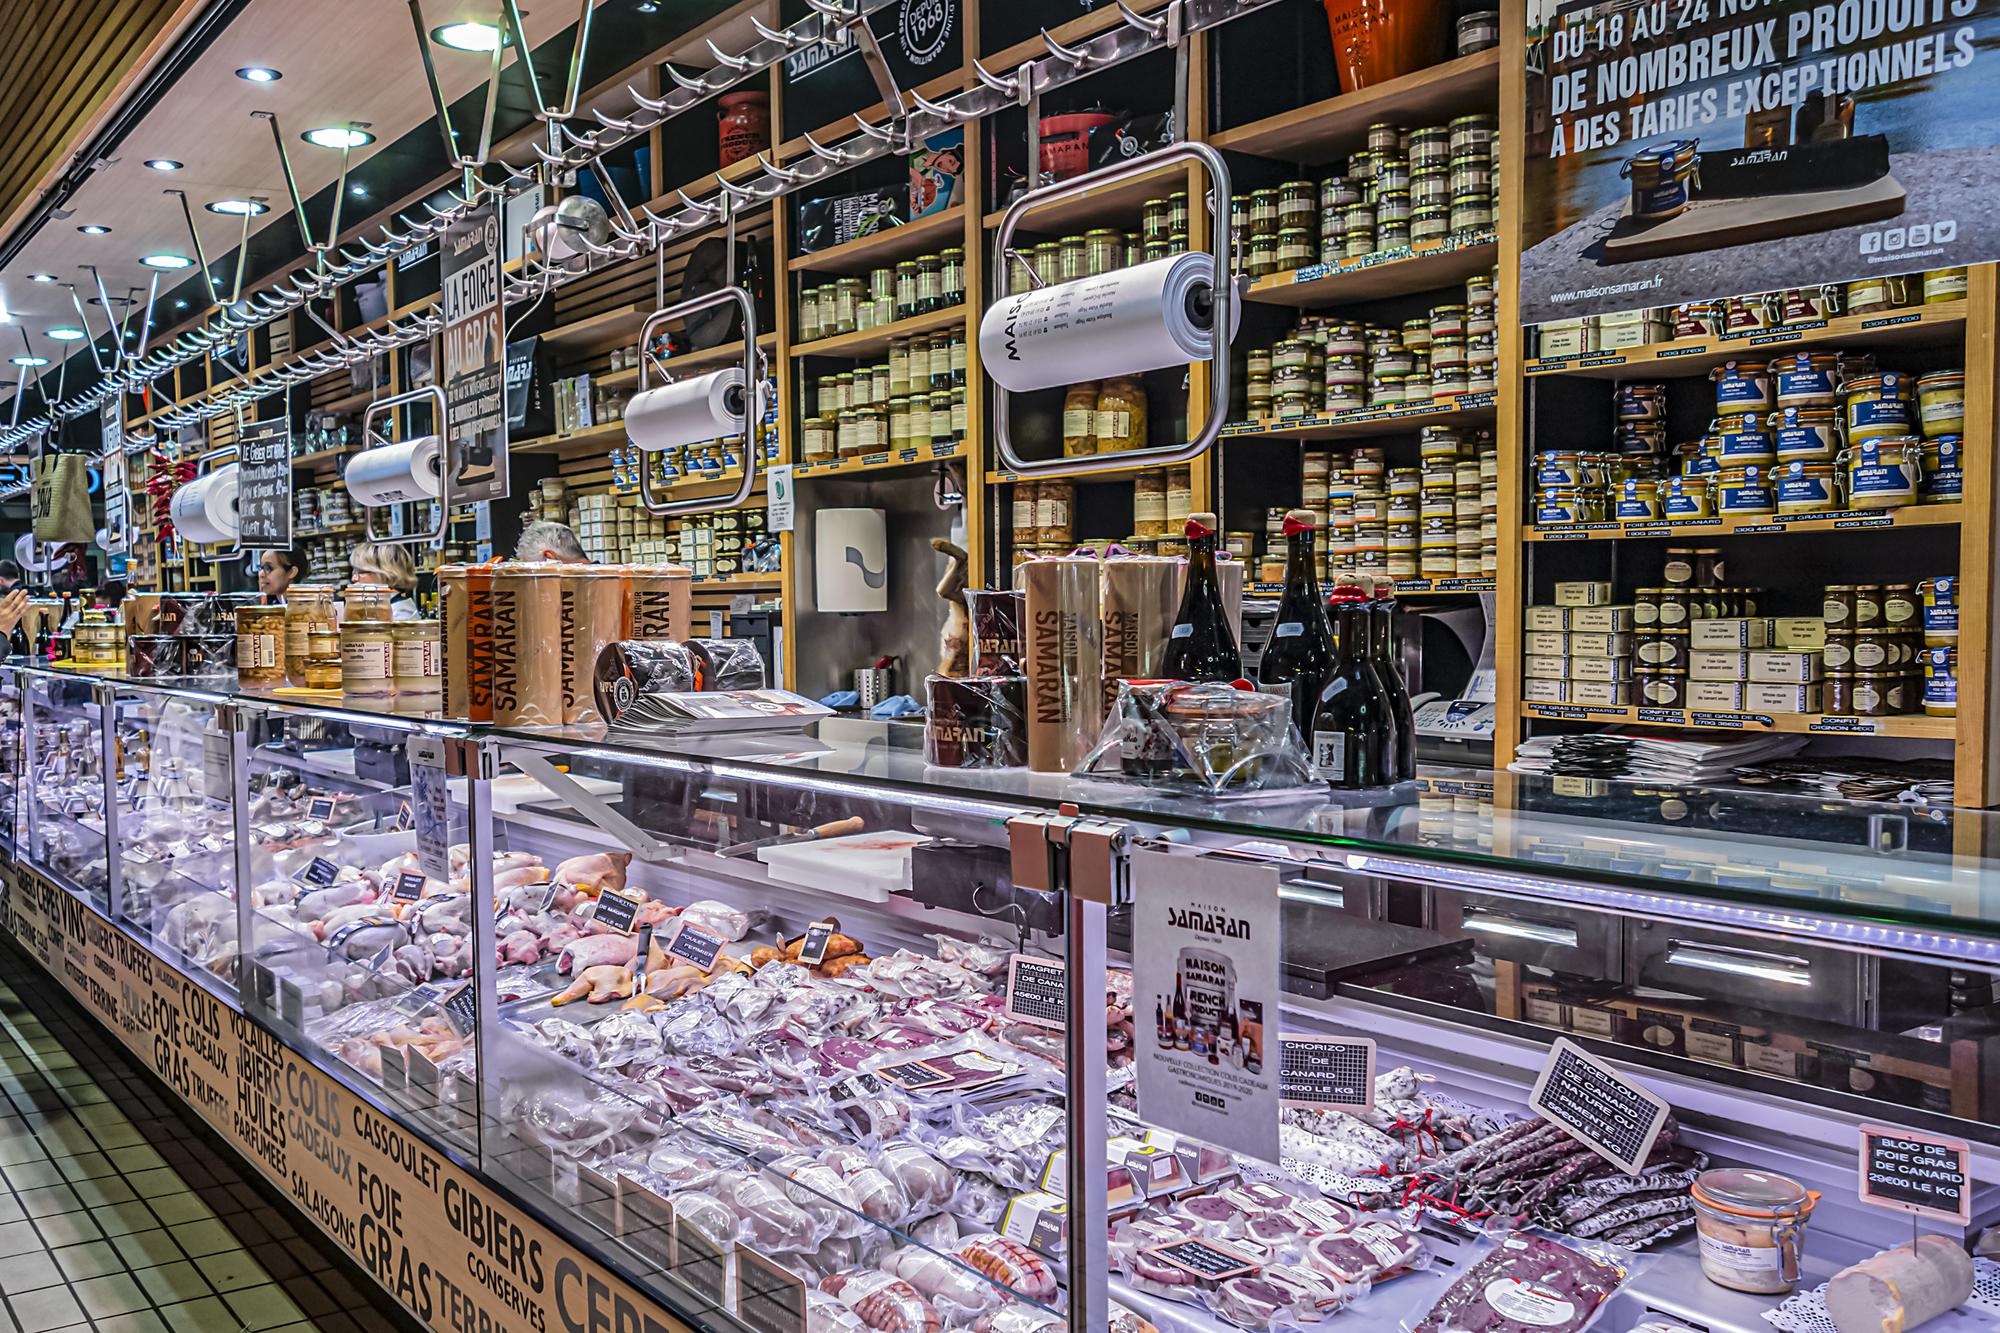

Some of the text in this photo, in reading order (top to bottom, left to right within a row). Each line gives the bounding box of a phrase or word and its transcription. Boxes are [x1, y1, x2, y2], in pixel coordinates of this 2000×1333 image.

[912, 3, 944, 42] 1968
[1334, 3, 1377, 24] MAISON
[1553, 24, 1585, 63] DU
[1595, 15, 1623, 51] 18
[1632, 2, 1666, 42] AU
[1677, 0, 1709, 30] 24
[1552, 69, 1587, 116] DE
[1597, 19, 1777, 104] NOMBREUX
[1550, 26, 1975, 158] À DES TARIFS EXCEPTIONNELS
[1730, 151, 1788, 167] SAMARAN
[453, 226, 483, 256] SAMARAN
[1867, 248, 1944, 264] @maisonsamaran
[446, 258, 496, 321] LA FOIRE
[1551, 275, 1664, 302] www.maisonsamaran.fr
[464, 310, 499, 367] GRAS
[1720, 333, 1738, 341] FOIE
[1742, 329, 1767, 337] GRAS
[1795, 322, 1826, 331] BOCAL
[634, 591, 642, 625] TERROIR
[473, 590, 494, 707] SAMARAN
[495, 590, 517, 712] SAMARAN
[561, 590, 575, 708] SAMARAN
[1035, 610, 1061, 724] SAMARAN
[60, 890, 86, 946] VINS
[1168, 907, 1251, 940] SAMARAN
[1190, 902, 1226, 912] MAISON
[114, 931, 153, 986] TRUFFES
[1021, 963, 1063, 976] MAGRET
[1021, 975, 1065, 989] DE CANA
[1186, 958, 1226, 976] MAISON
[1186, 971, 1226, 987] SAMARAN
[88, 976, 118, 1023] TERRINE
[152, 991, 180, 1046] FOIE
[182, 983, 220, 1040] COLIS
[1014, 990, 1055, 1004] 45€00 LE
[1189, 990, 1226, 1008] RENCH
[183, 1022, 229, 1078] CADEAUX
[229, 1010, 284, 1070] VOLAILLES
[1286, 1042, 1345, 1052] CHORIZO
[1311, 1057, 1329, 1065] DE
[154, 1033, 190, 1098] GRAS
[1153, 1053, 1181, 1066] NOUVELLE
[1183, 1061, 1219, 1077] COLLECTION
[1239, 1077, 1269, 1090] CADEAUX
[1168, 1066, 1221, 1086] GASTRONOMIQUES
[1281, 1069, 1335, 1079] CANARD
[1575, 1059, 1638, 1101] FICELLOU
[191, 1070, 230, 1126] TRUFFES
[237, 1076, 286, 1149] HUILES
[286, 1061, 341, 1138] COLIS
[1314, 1085, 1331, 1094] LE
[1334, 1086, 1354, 1095] KG
[1560, 1080, 1635, 1130] NATURE OU
[1564, 1069, 1639, 1118] DE CANARD
[1547, 1101, 1622, 1155] 56€00 LE KG
[1560, 1095, 1616, 1135] PIMENTE
[234, 1111, 287, 1179] PARFUMEES
[288, 1108, 352, 1186] CADEAUX
[353, 1104, 440, 1194] CASSOULET
[1127, 1159, 1148, 1172] SAMARAN
[1876, 1150, 1957, 1170] FOIE GRAS
[1881, 1138, 1946, 1156] BLOC DE
[1868, 1172, 1959, 1198] 29€00 LE KG
[1875, 1161, 1963, 1183] DE CANARD
[291, 1170, 356, 1250] SALAISONS
[358, 1162, 403, 1239] FOIE
[444, 1178, 545, 1295] GIBIERS
[1038, 1218, 1059, 1232] SAMARAN
[358, 1213, 433, 1323] GRAS
[467, 1251, 546, 1333] CONSERVES
